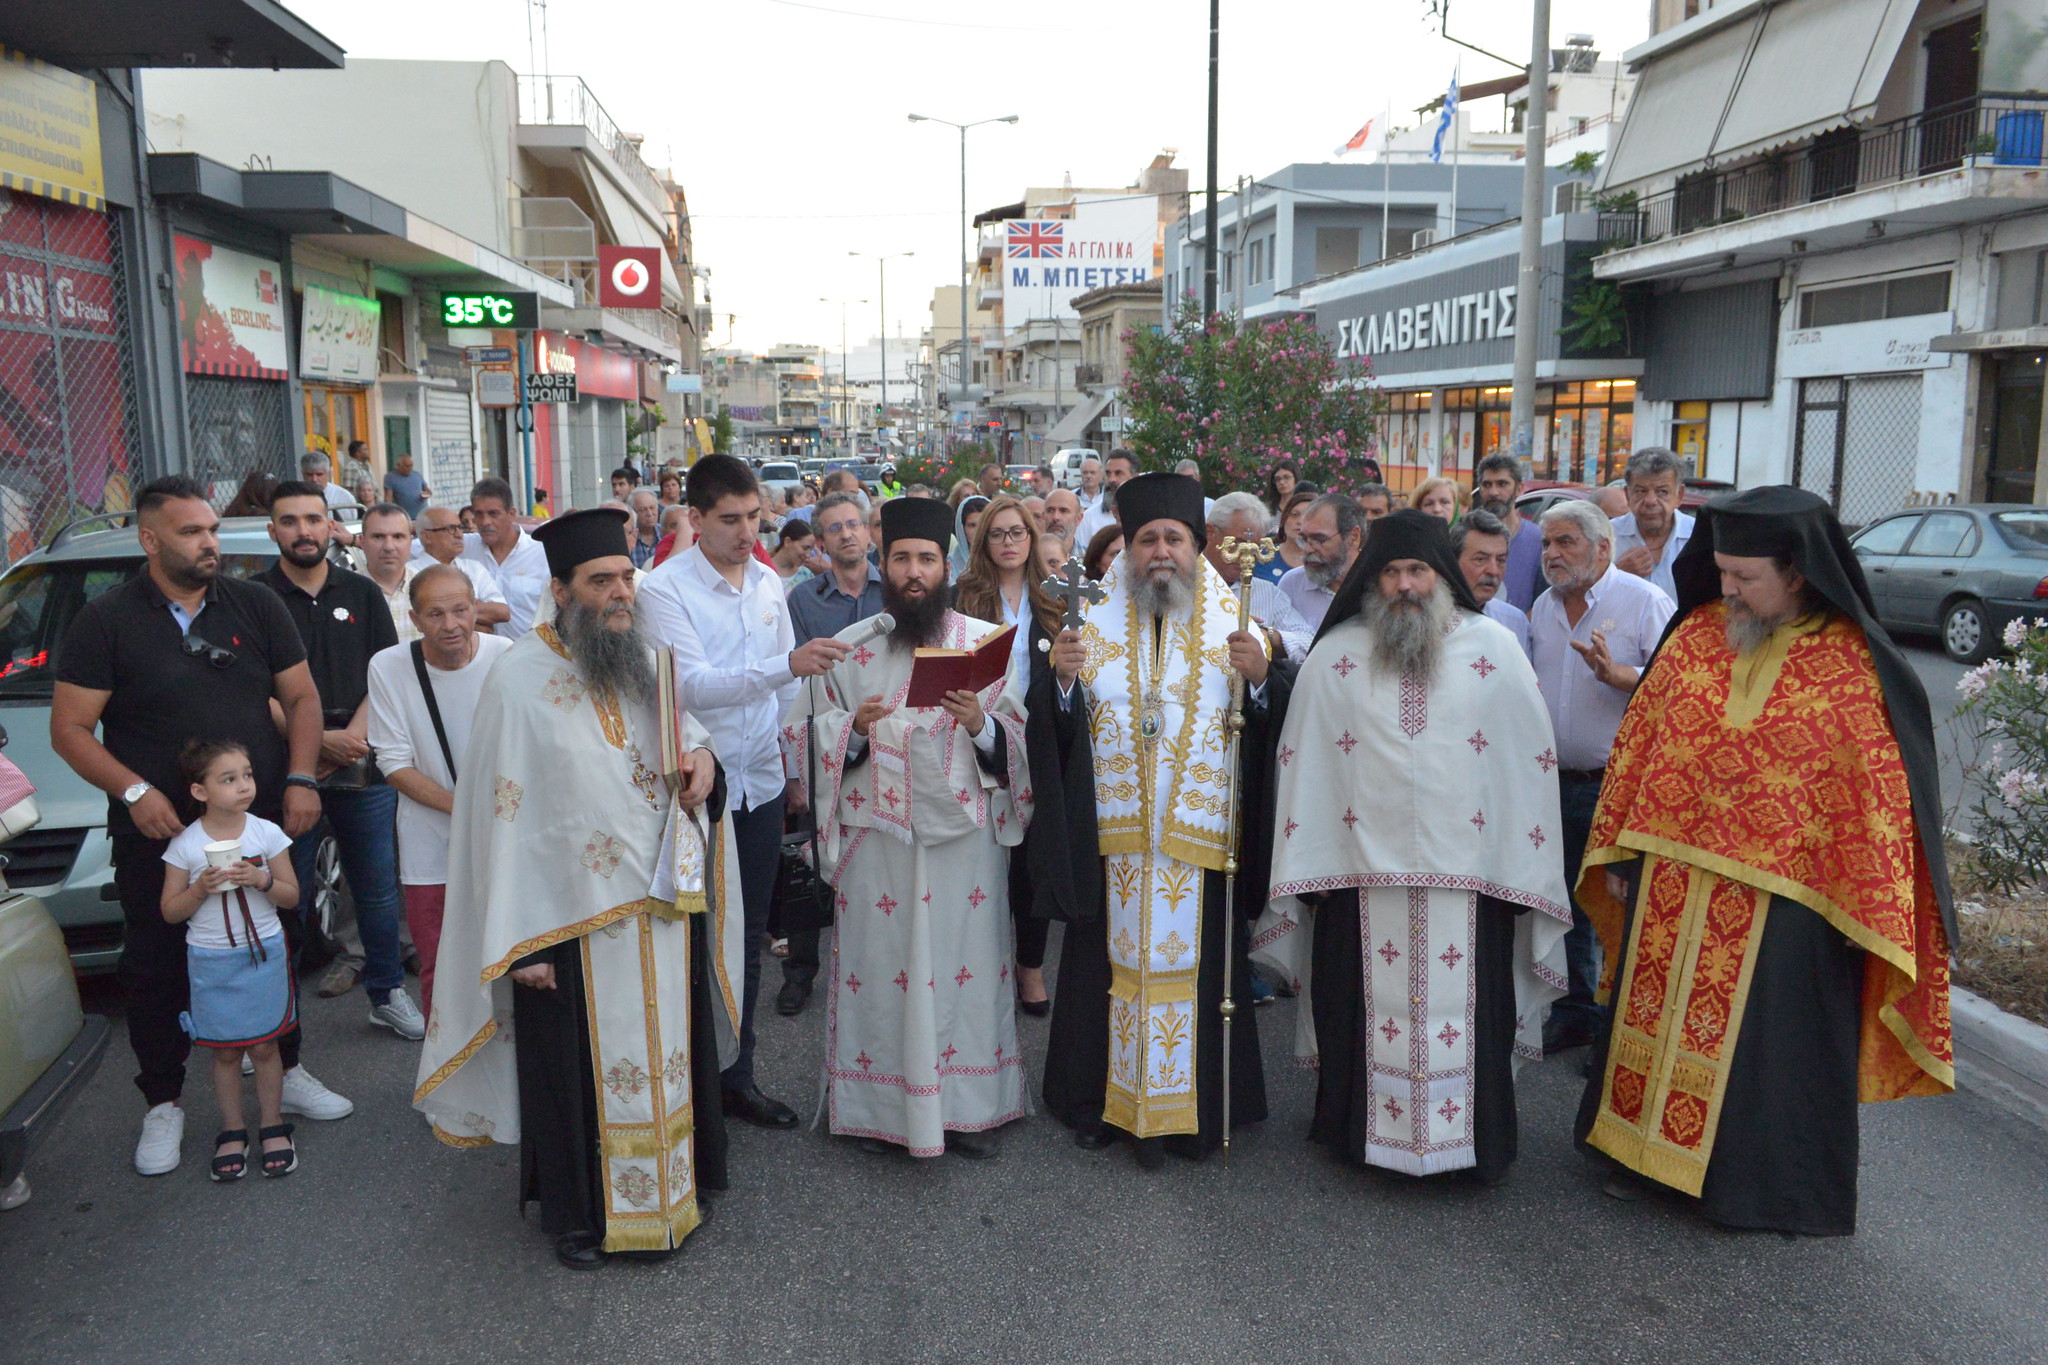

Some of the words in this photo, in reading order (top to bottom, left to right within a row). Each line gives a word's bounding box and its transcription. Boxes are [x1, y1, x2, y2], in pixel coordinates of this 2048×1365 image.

[1068, 241, 1133, 259] ΑΓΓΛΙΚΑ
[230, 306, 272, 331] BERLING
[445, 295, 513, 324] 35°C
[1338, 286, 1518, 359] ΣΚΛΑΒΕΝΙΤΗΣ
[526, 388, 570, 401] ΨΩΜΙ
